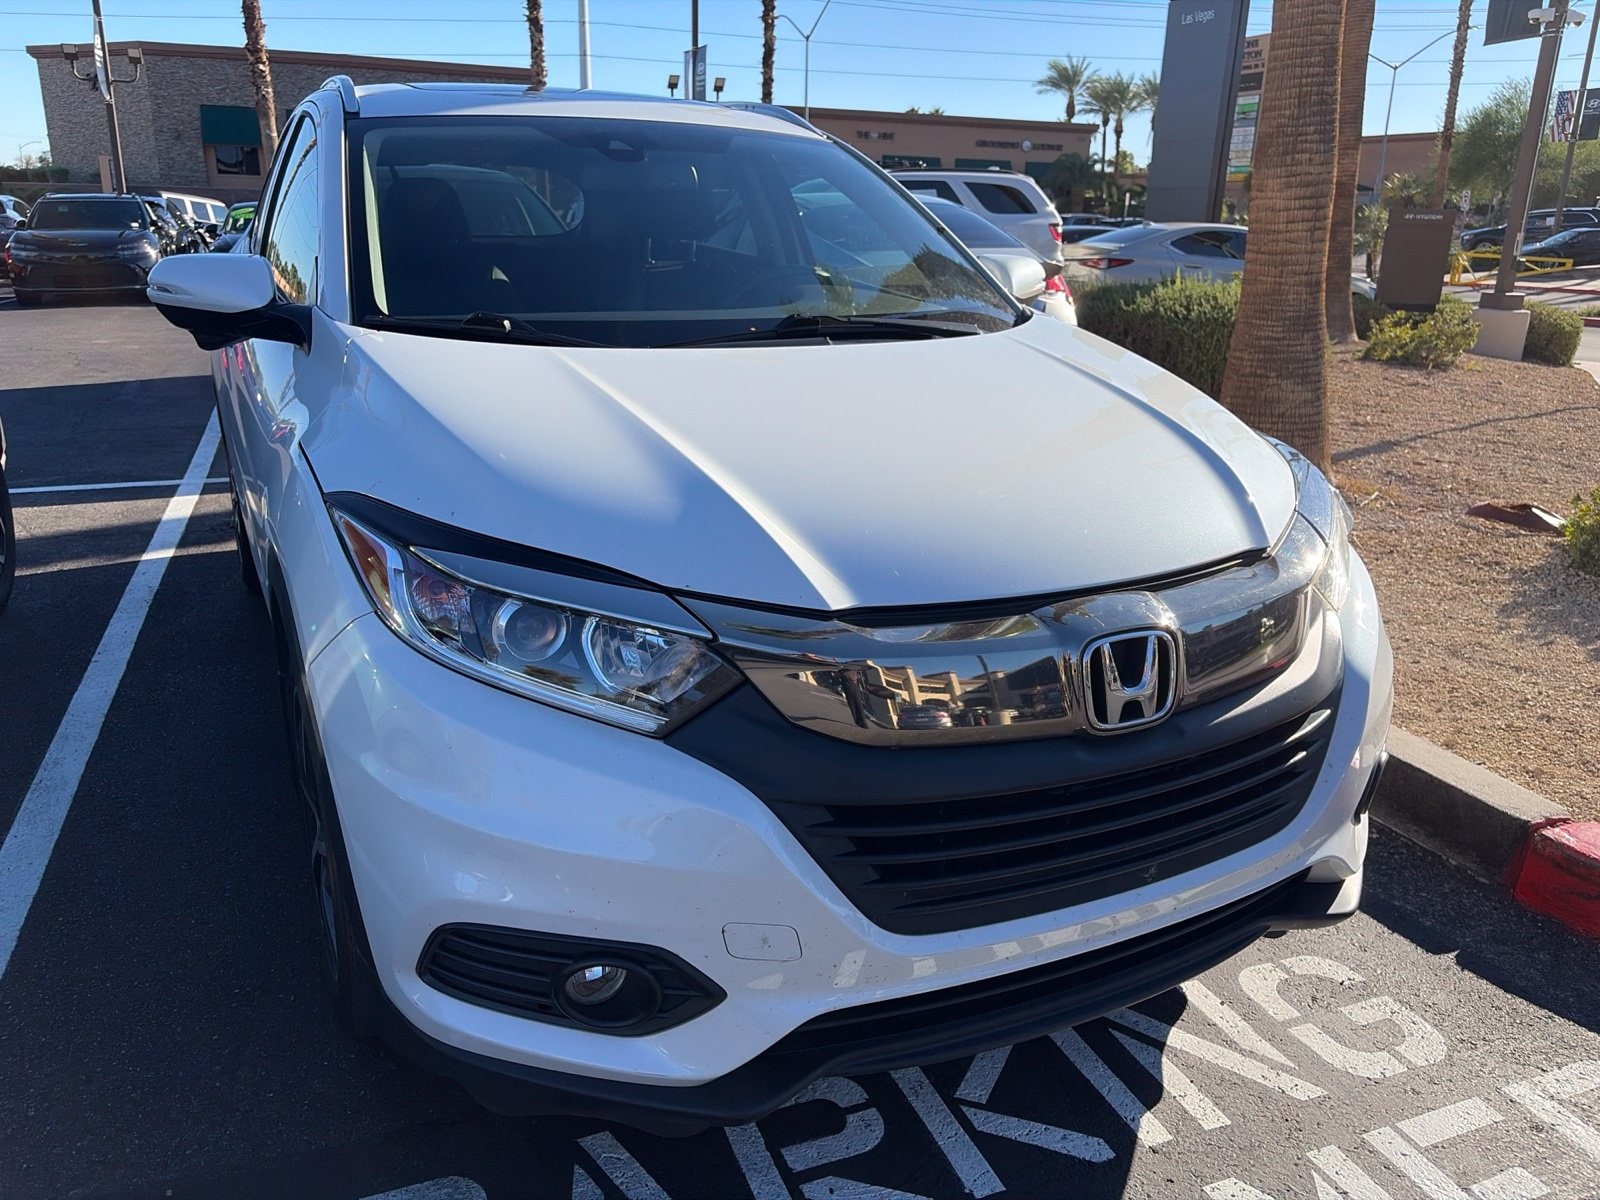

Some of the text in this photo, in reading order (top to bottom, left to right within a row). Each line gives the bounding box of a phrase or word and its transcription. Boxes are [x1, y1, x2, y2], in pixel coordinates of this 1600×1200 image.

[1181, 9, 1215, 25] Las Vegas
[359, 955, 1448, 1200] RKING
